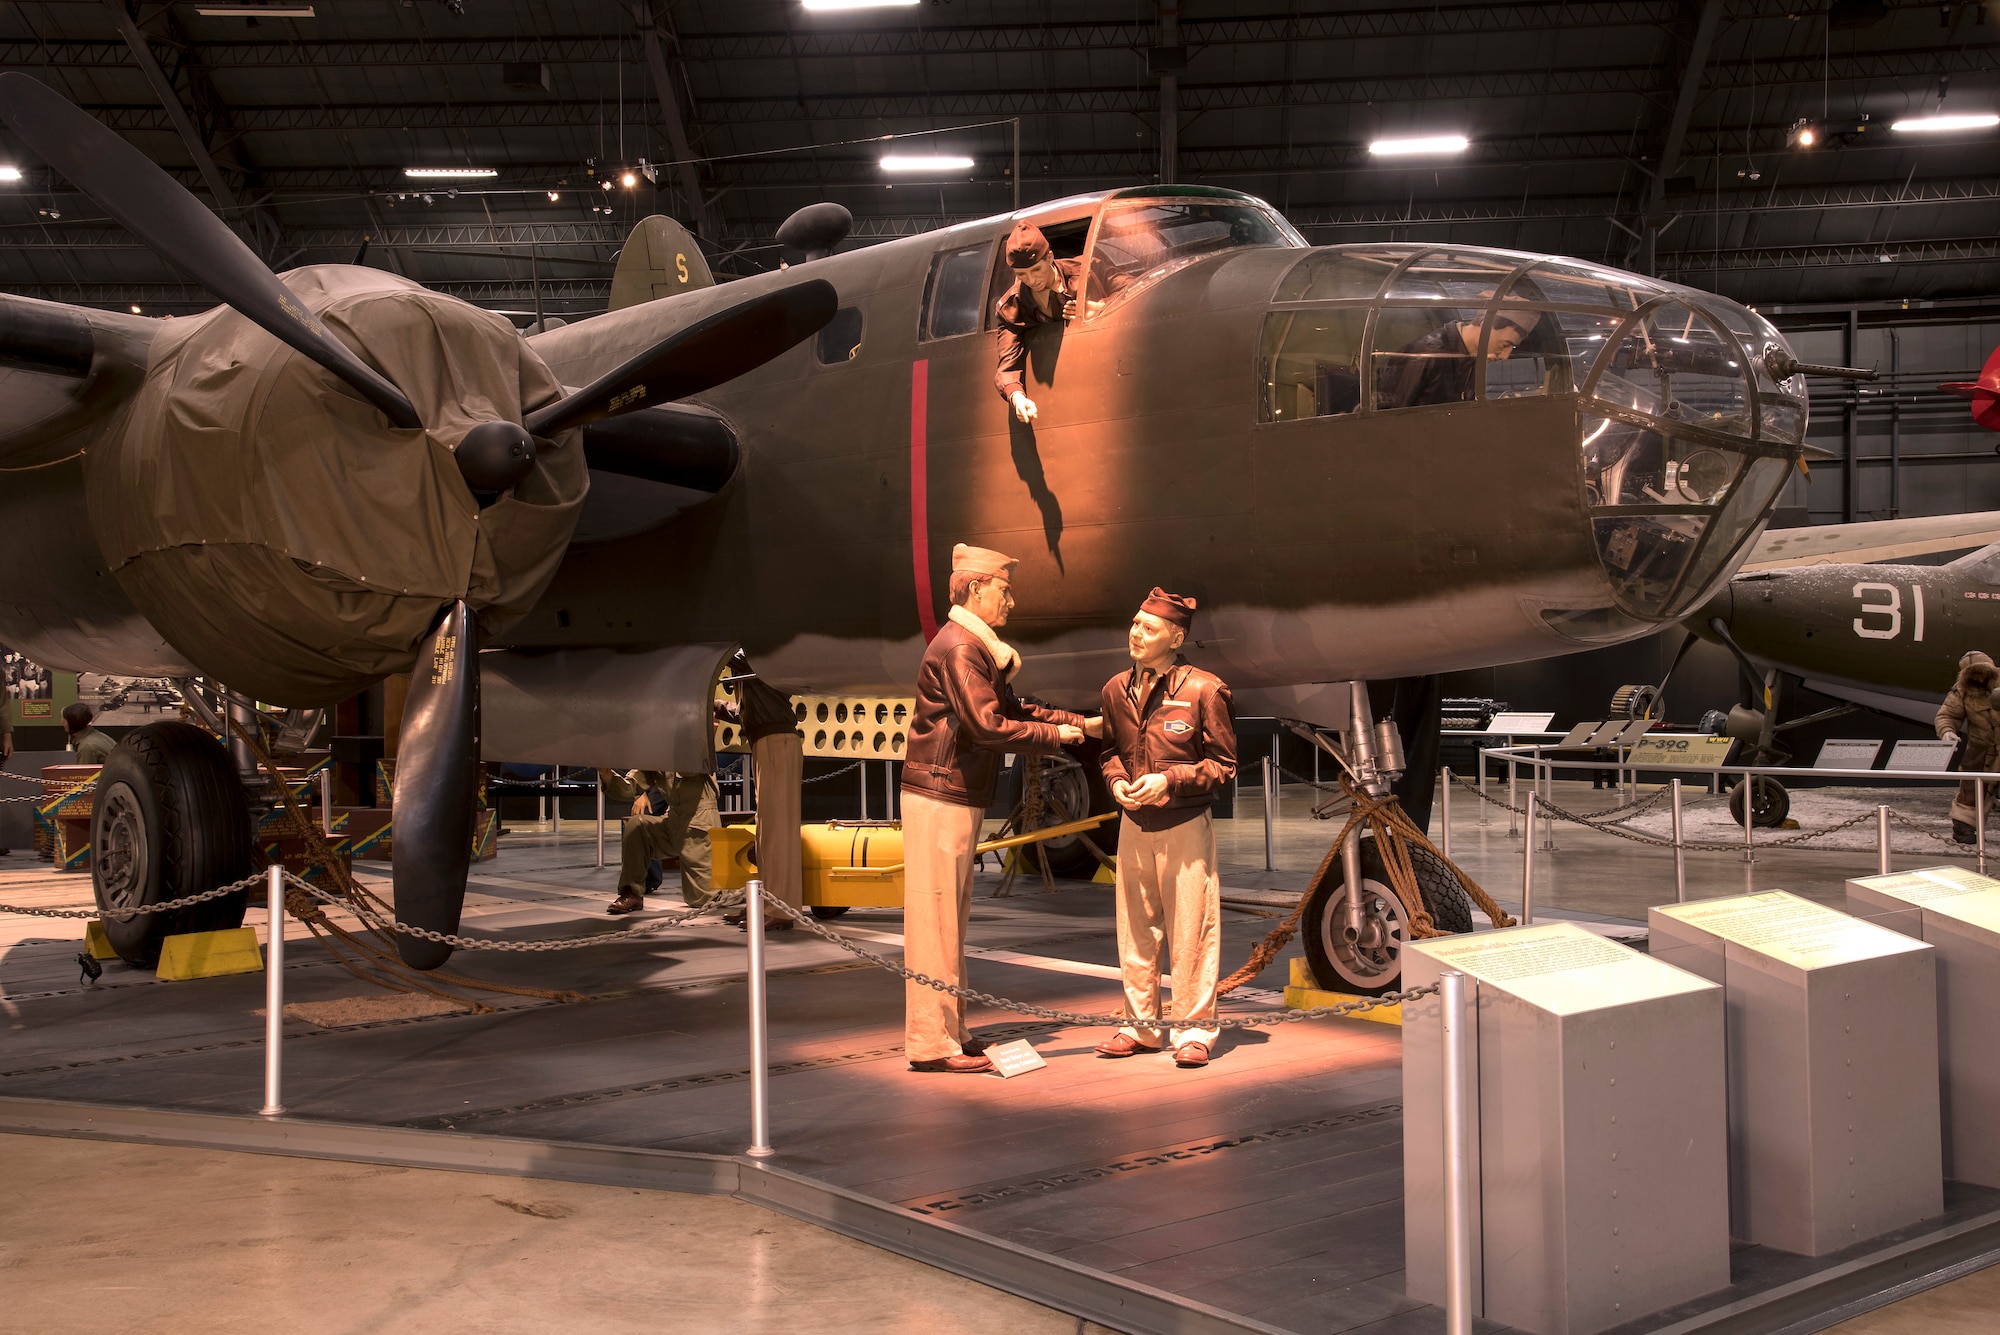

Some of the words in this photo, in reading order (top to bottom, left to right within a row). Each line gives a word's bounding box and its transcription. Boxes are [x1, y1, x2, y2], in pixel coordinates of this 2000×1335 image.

[676, 253, 688, 283] S
[1852, 582, 1924, 641] 31
[1638, 739, 1689, 750] P-39Q
